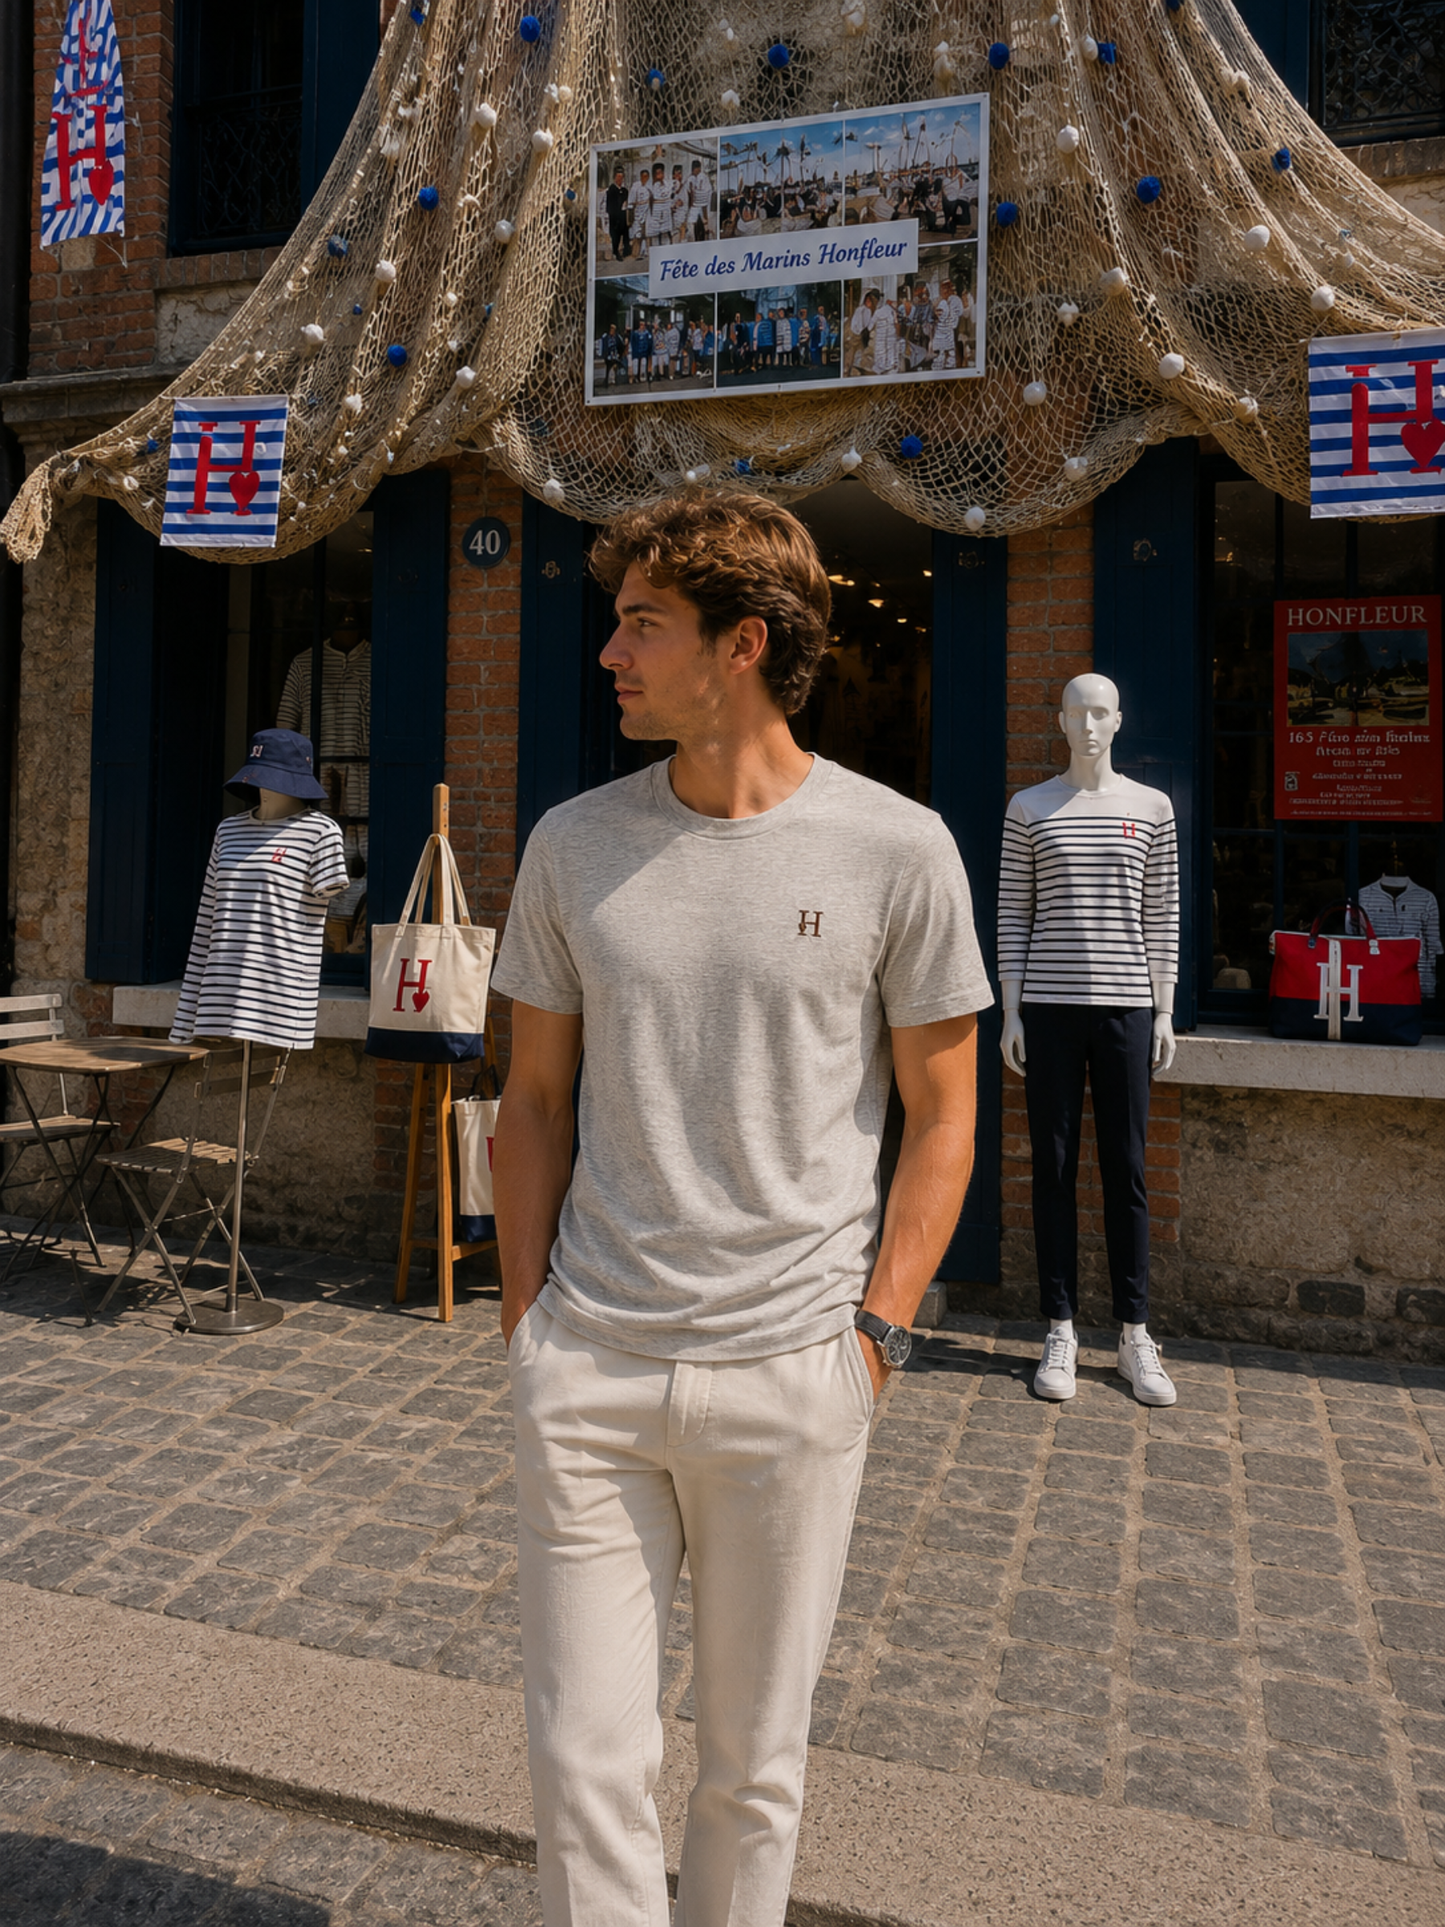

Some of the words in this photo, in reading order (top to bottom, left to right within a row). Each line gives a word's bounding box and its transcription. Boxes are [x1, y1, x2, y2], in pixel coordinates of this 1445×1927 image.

[660, 258, 699, 281] Fête
[705, 254, 735, 276] des
[741, 248, 810, 273] Marins
[818, 238, 908, 270] Honfleur
[468, 532, 501, 555] 40
[1287, 605, 1427, 626] HONFLEUR
[797, 909, 824, 938] H
[393, 958, 434, 1013] H
